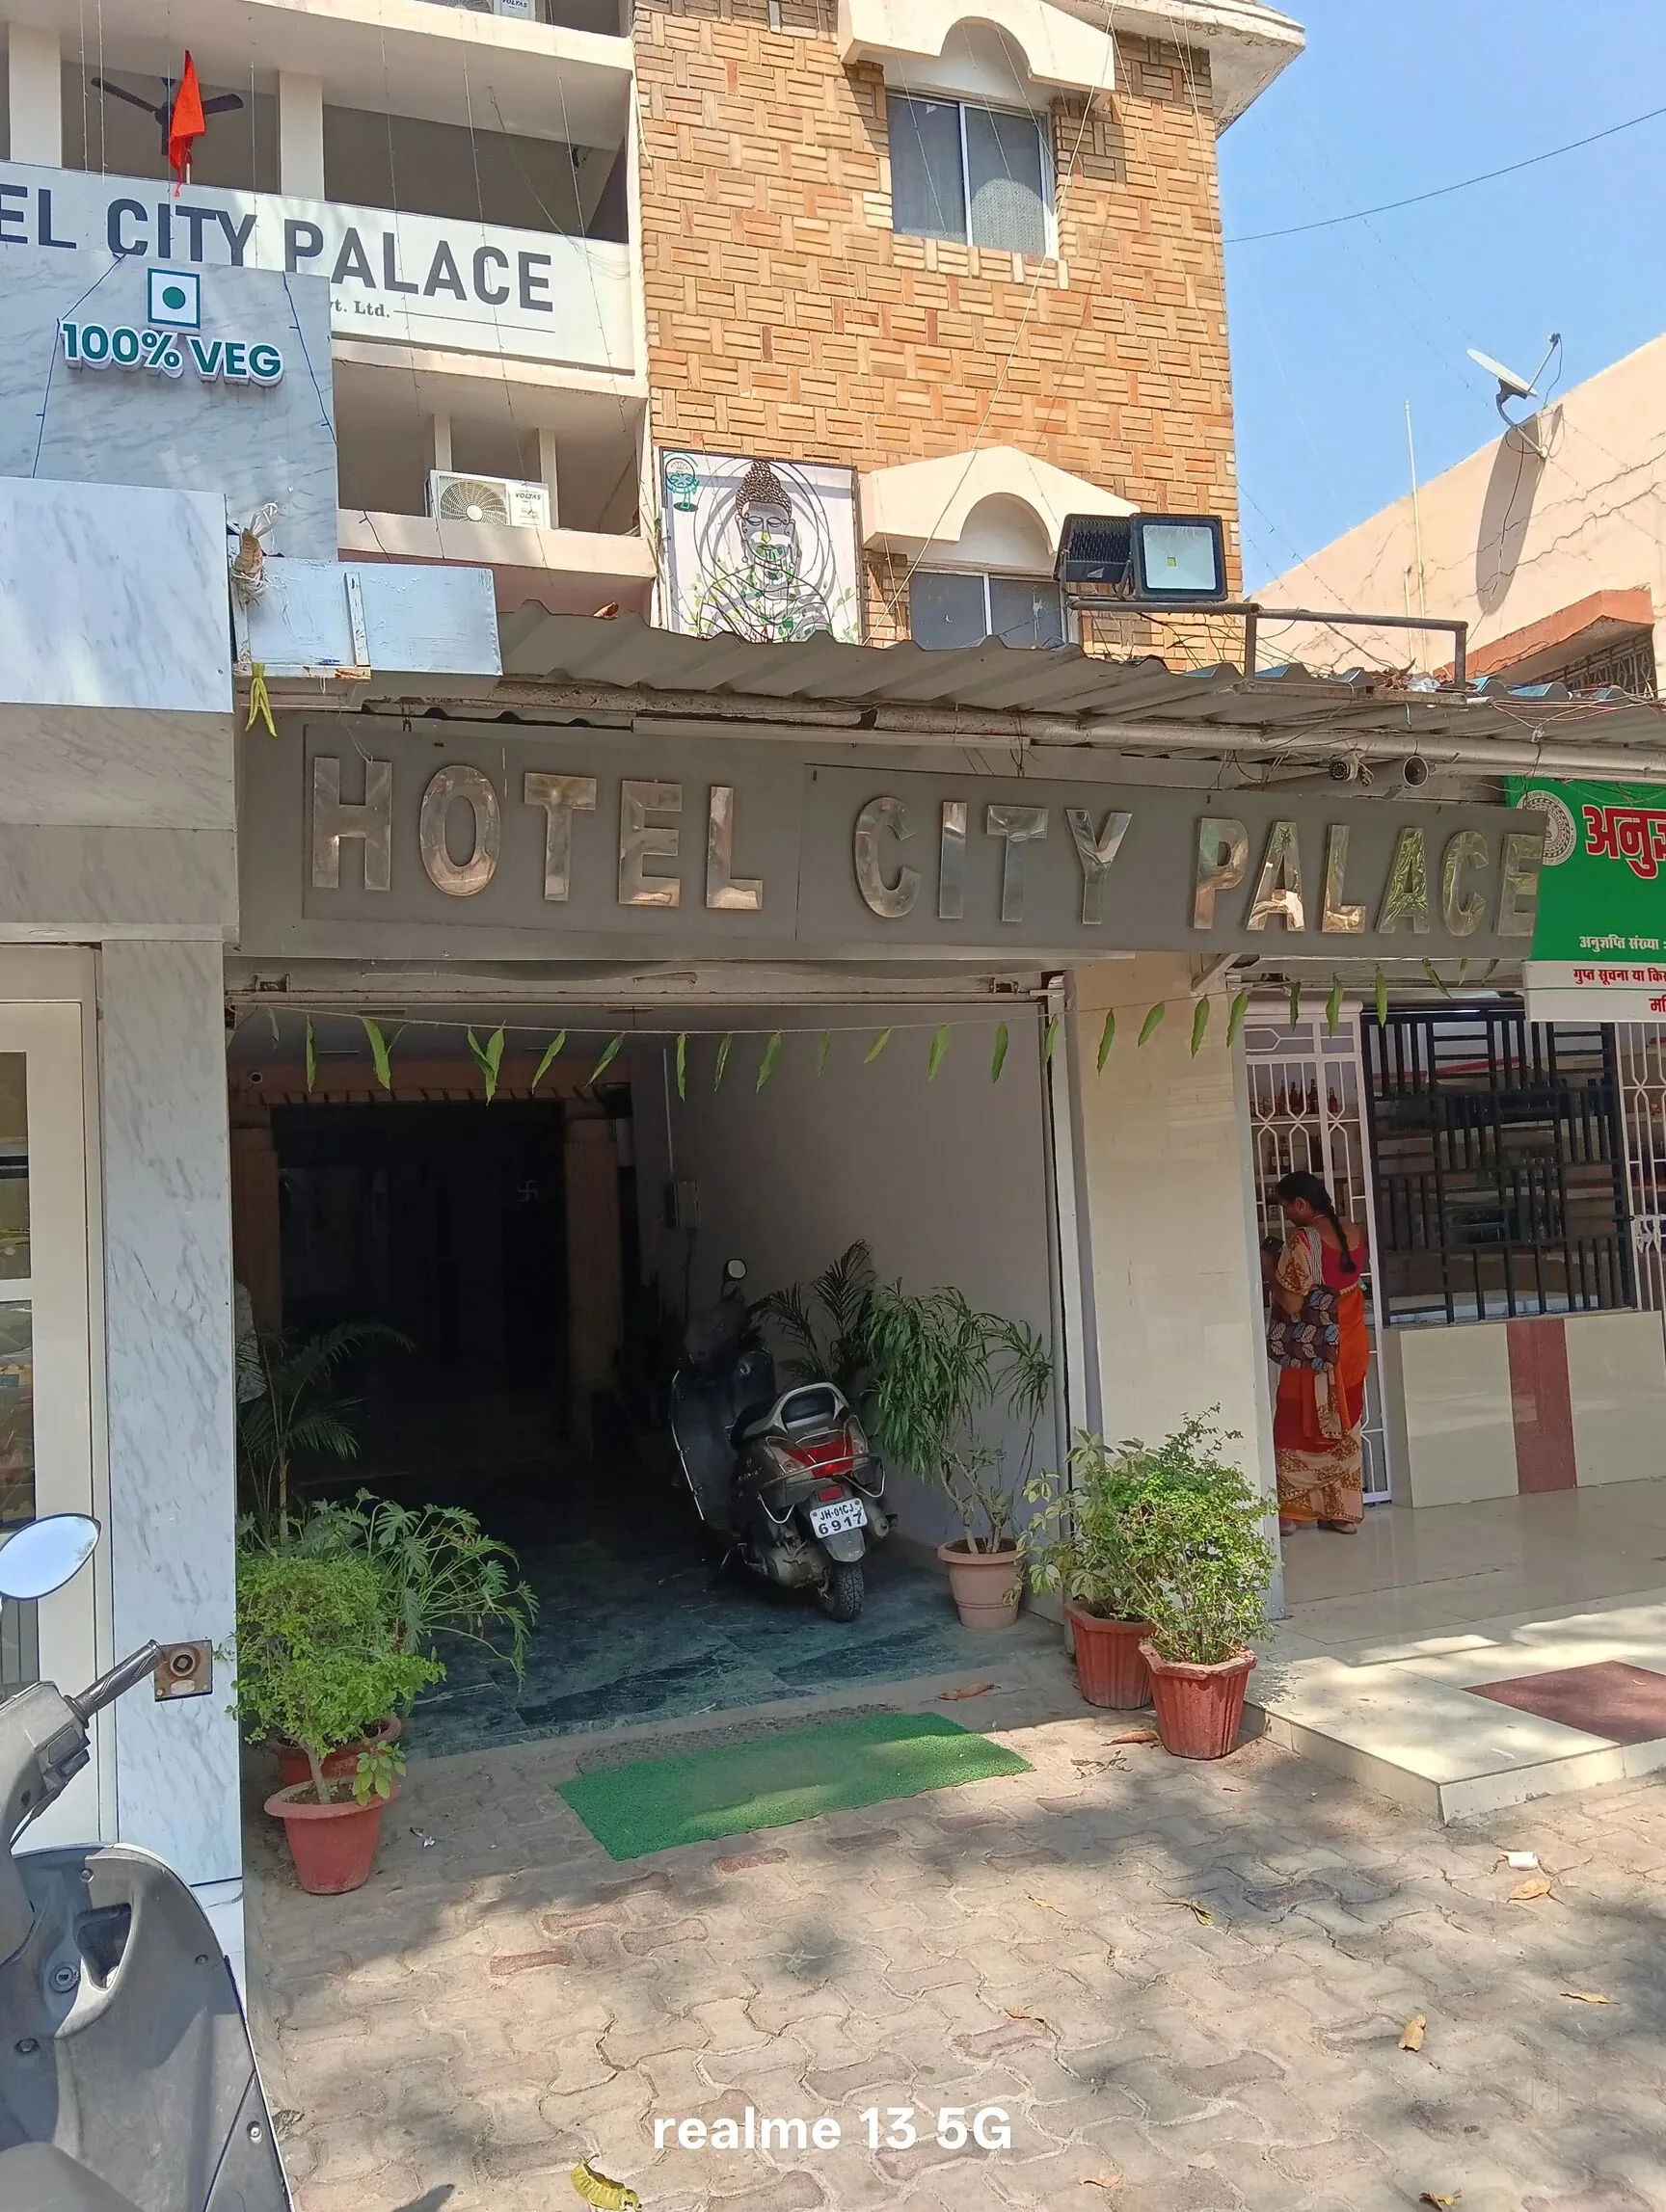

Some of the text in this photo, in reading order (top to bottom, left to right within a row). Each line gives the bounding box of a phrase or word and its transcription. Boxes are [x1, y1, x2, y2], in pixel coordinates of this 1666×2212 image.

[0, 184, 553, 312] EL CITY PALACE
[354, 301, 390, 318] Ltd.
[61, 321, 283, 380] 100% VEG
[515, 492, 542, 500] VOLTAS
[311, 755, 1543, 938] HOTEL CITY PALACE
[1628, 935, 1659, 950] संख्या
[1572, 968, 1666, 985] गुप्त सूचना या कि
[818, 1507, 864, 1535] 6917
